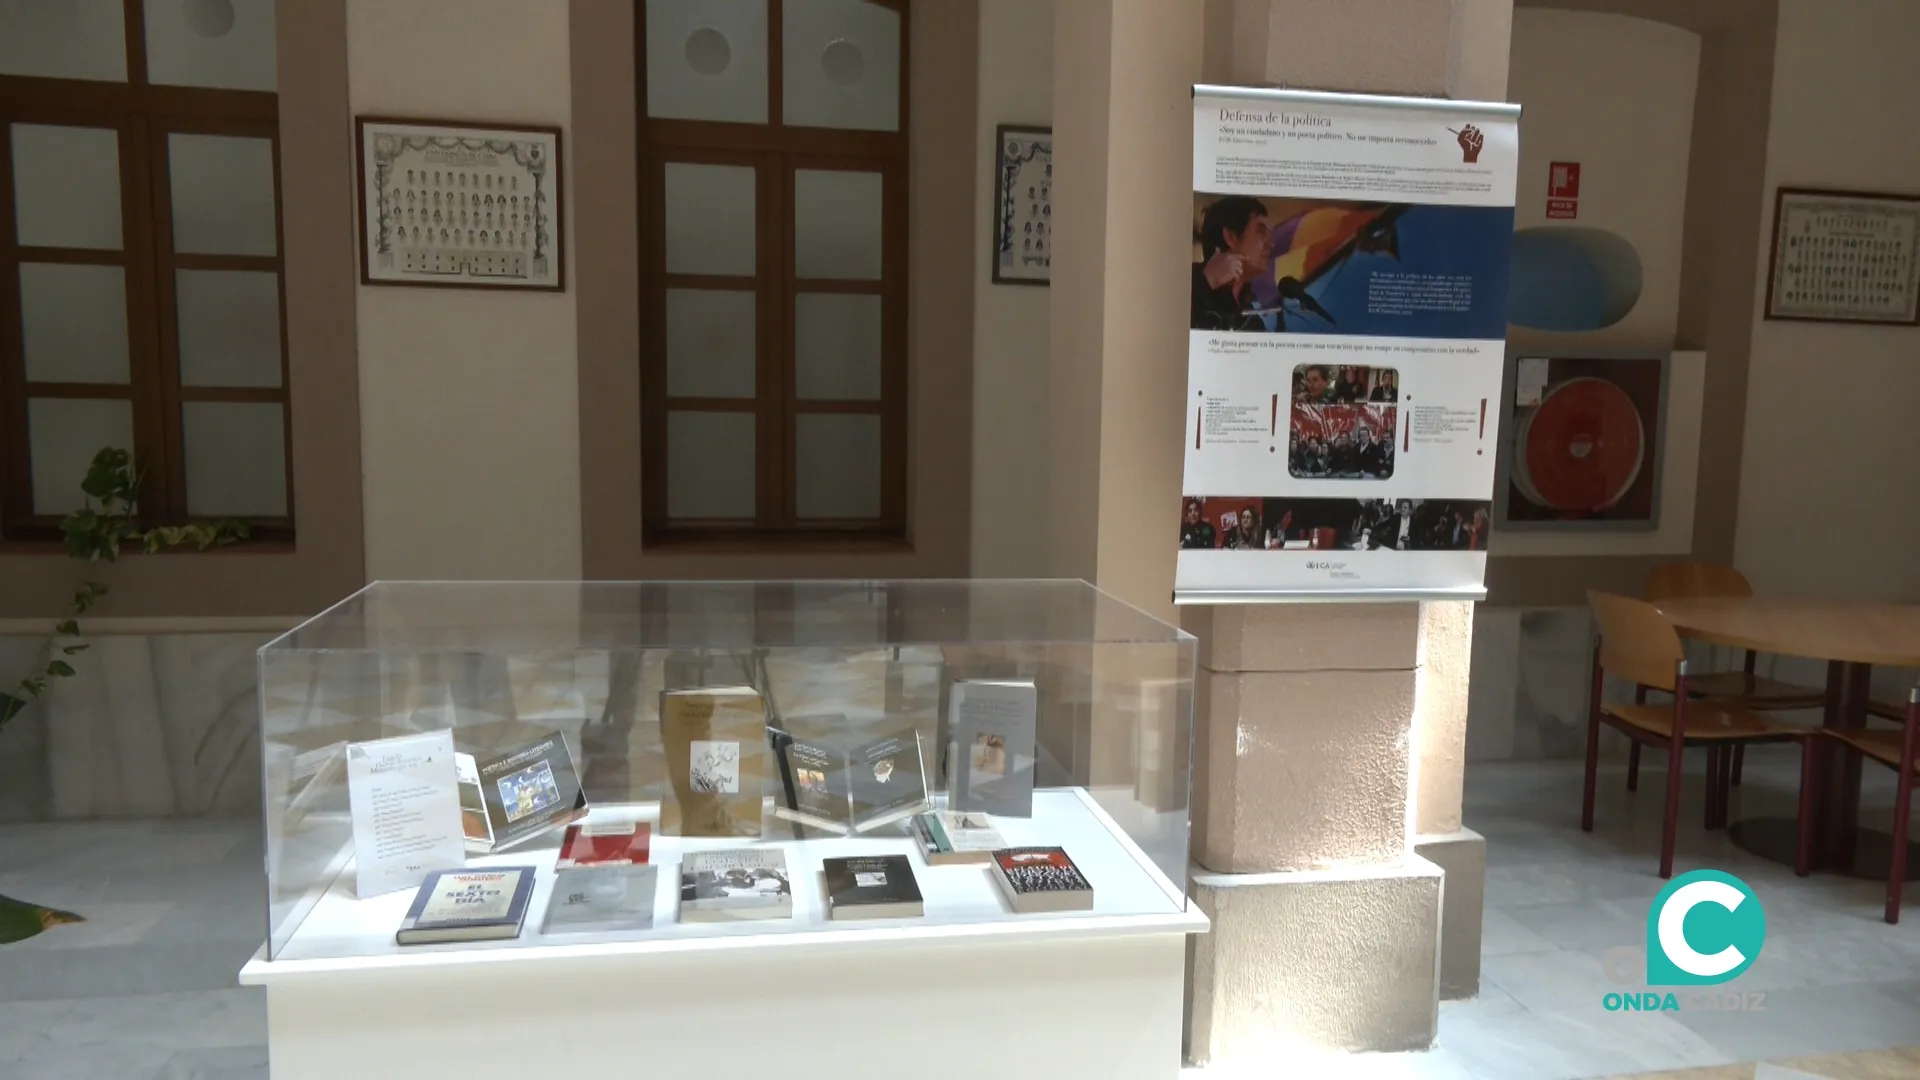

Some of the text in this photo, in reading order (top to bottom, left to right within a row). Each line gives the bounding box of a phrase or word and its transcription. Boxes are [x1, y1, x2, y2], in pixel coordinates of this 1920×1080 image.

[1220, 108, 1332, 128] Defensa de la política
[1246, 127, 1281, 136] ciudadano
[1297, 131, 1316, 140] poeta
[1346, 132, 1356, 141] No
[1368, 134, 1394, 144] importa
